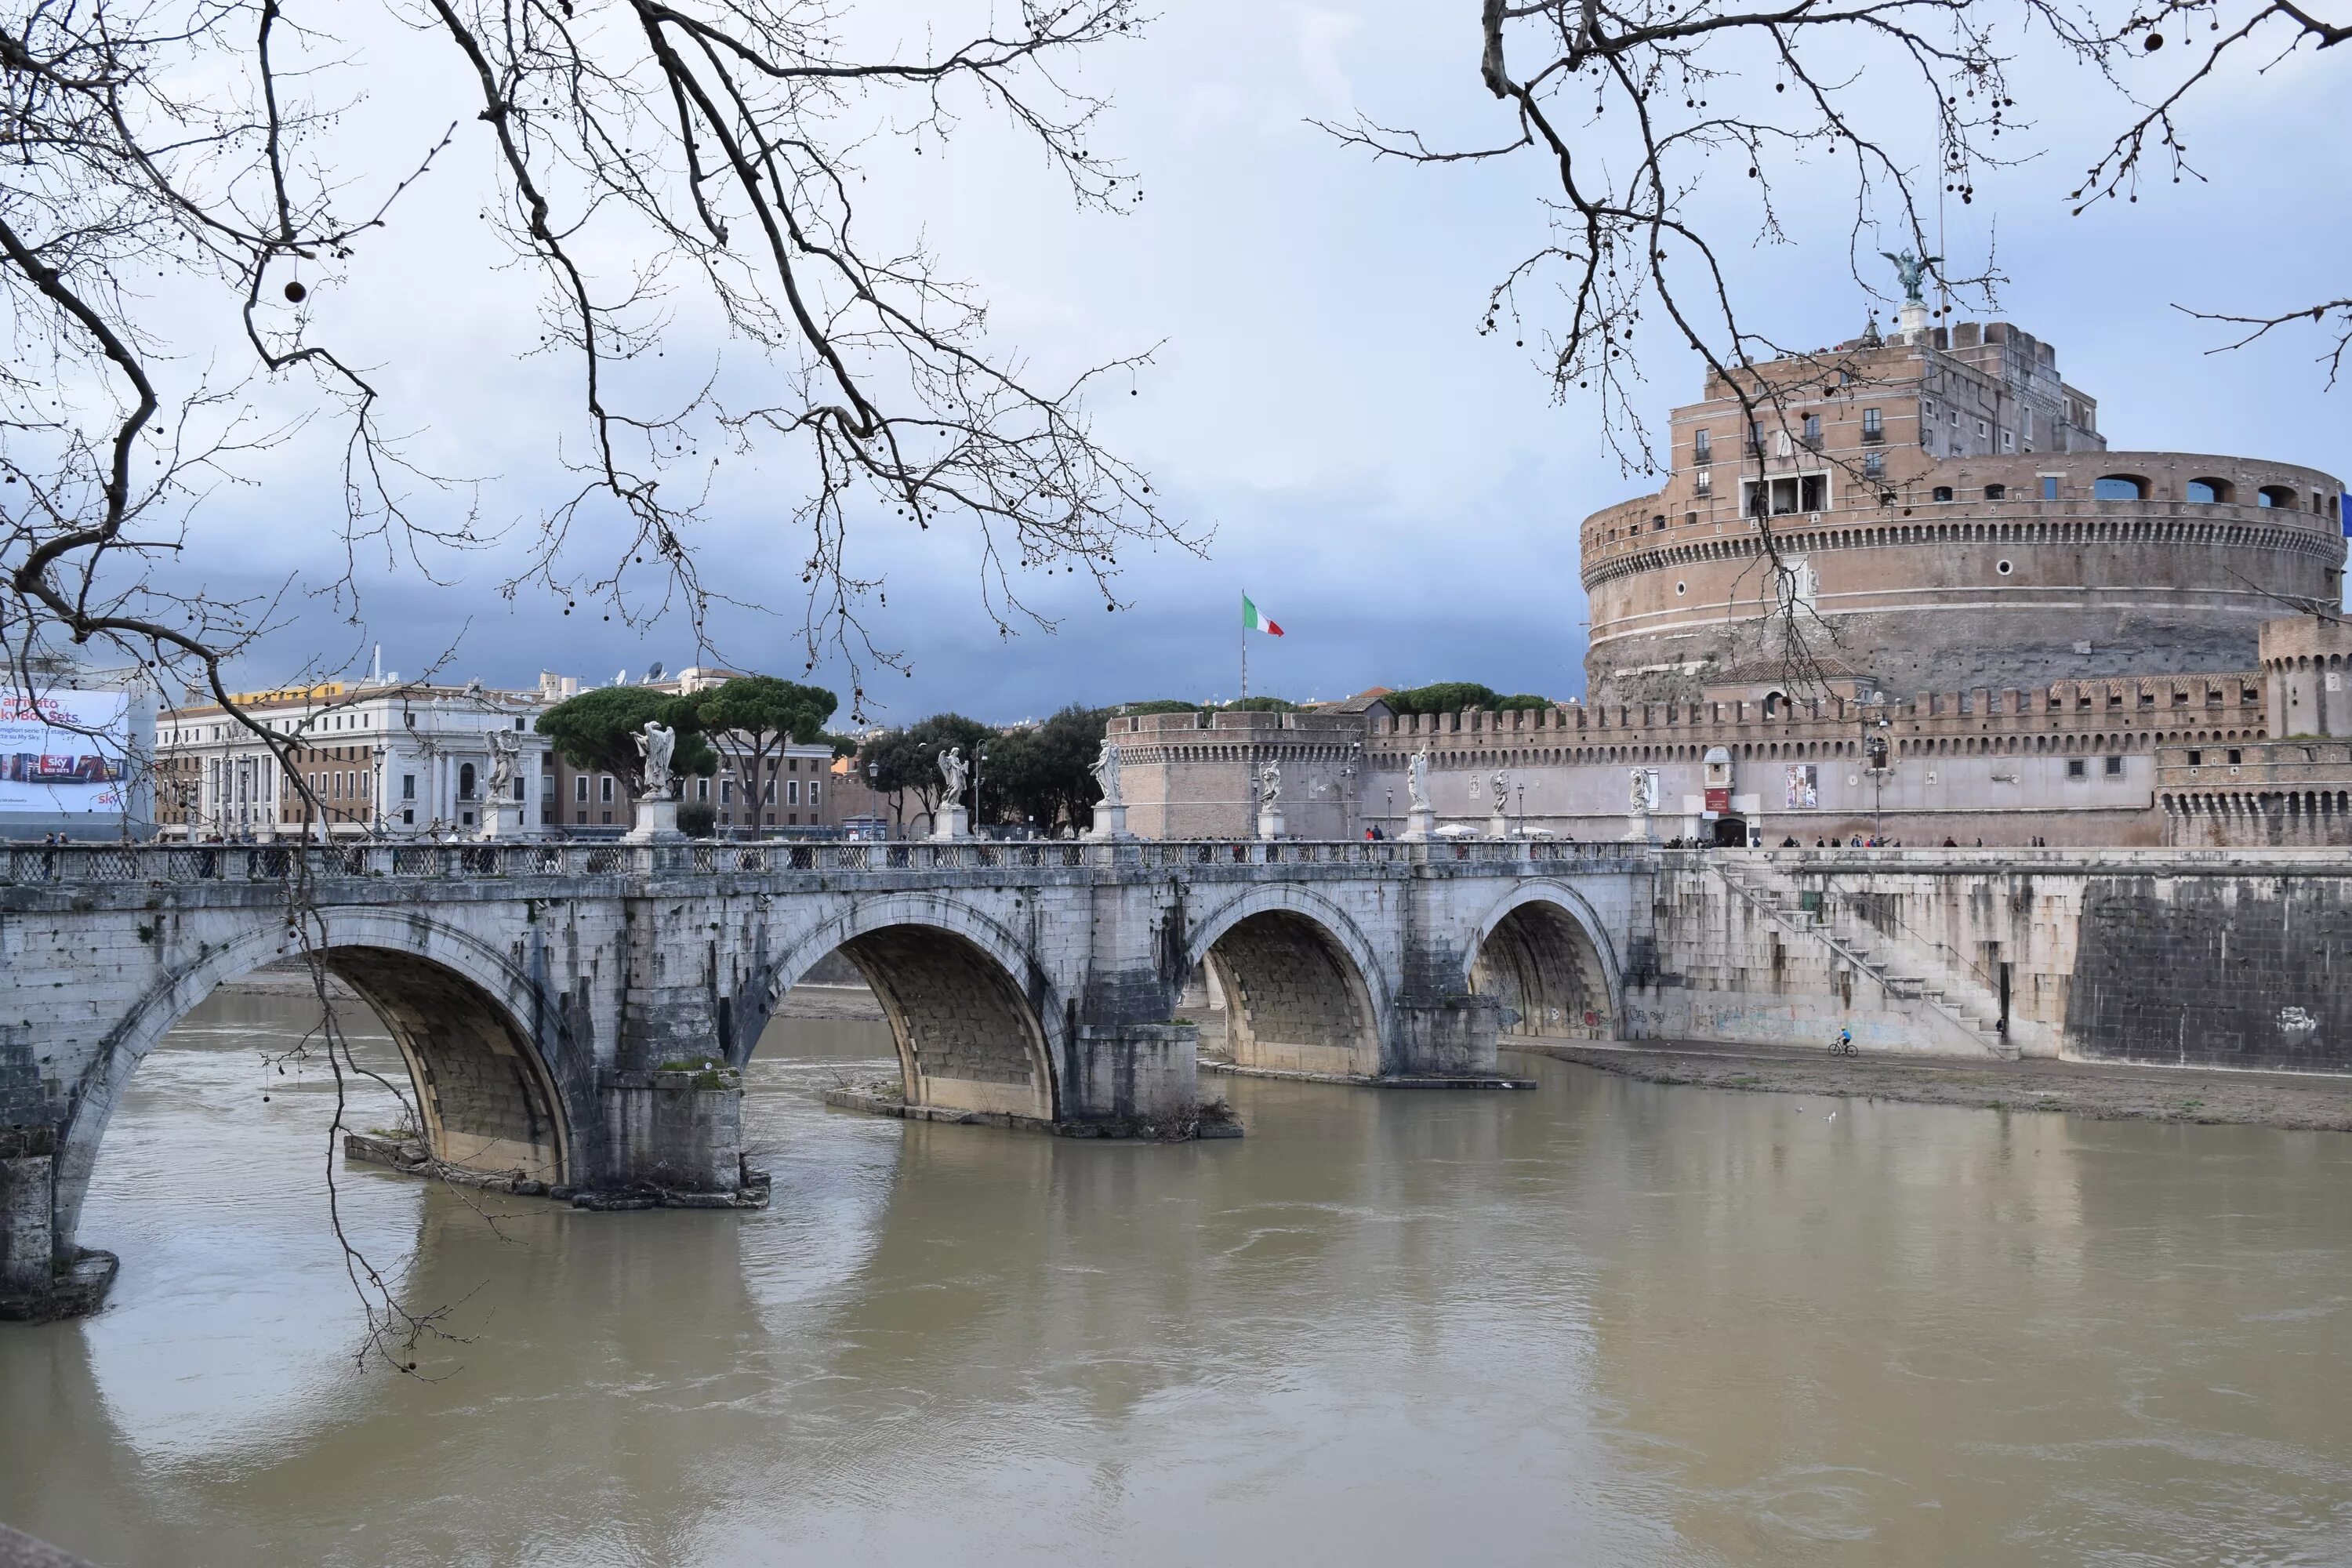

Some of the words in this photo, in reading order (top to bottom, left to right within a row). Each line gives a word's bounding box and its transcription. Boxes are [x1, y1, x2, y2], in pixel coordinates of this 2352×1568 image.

[0, 709, 16, 723] ky
[21, 710, 45, 721] Bo
[49, 710, 82, 723] Sets.
[48, 755, 67, 768] sky
[99, 793, 118, 806] sky
